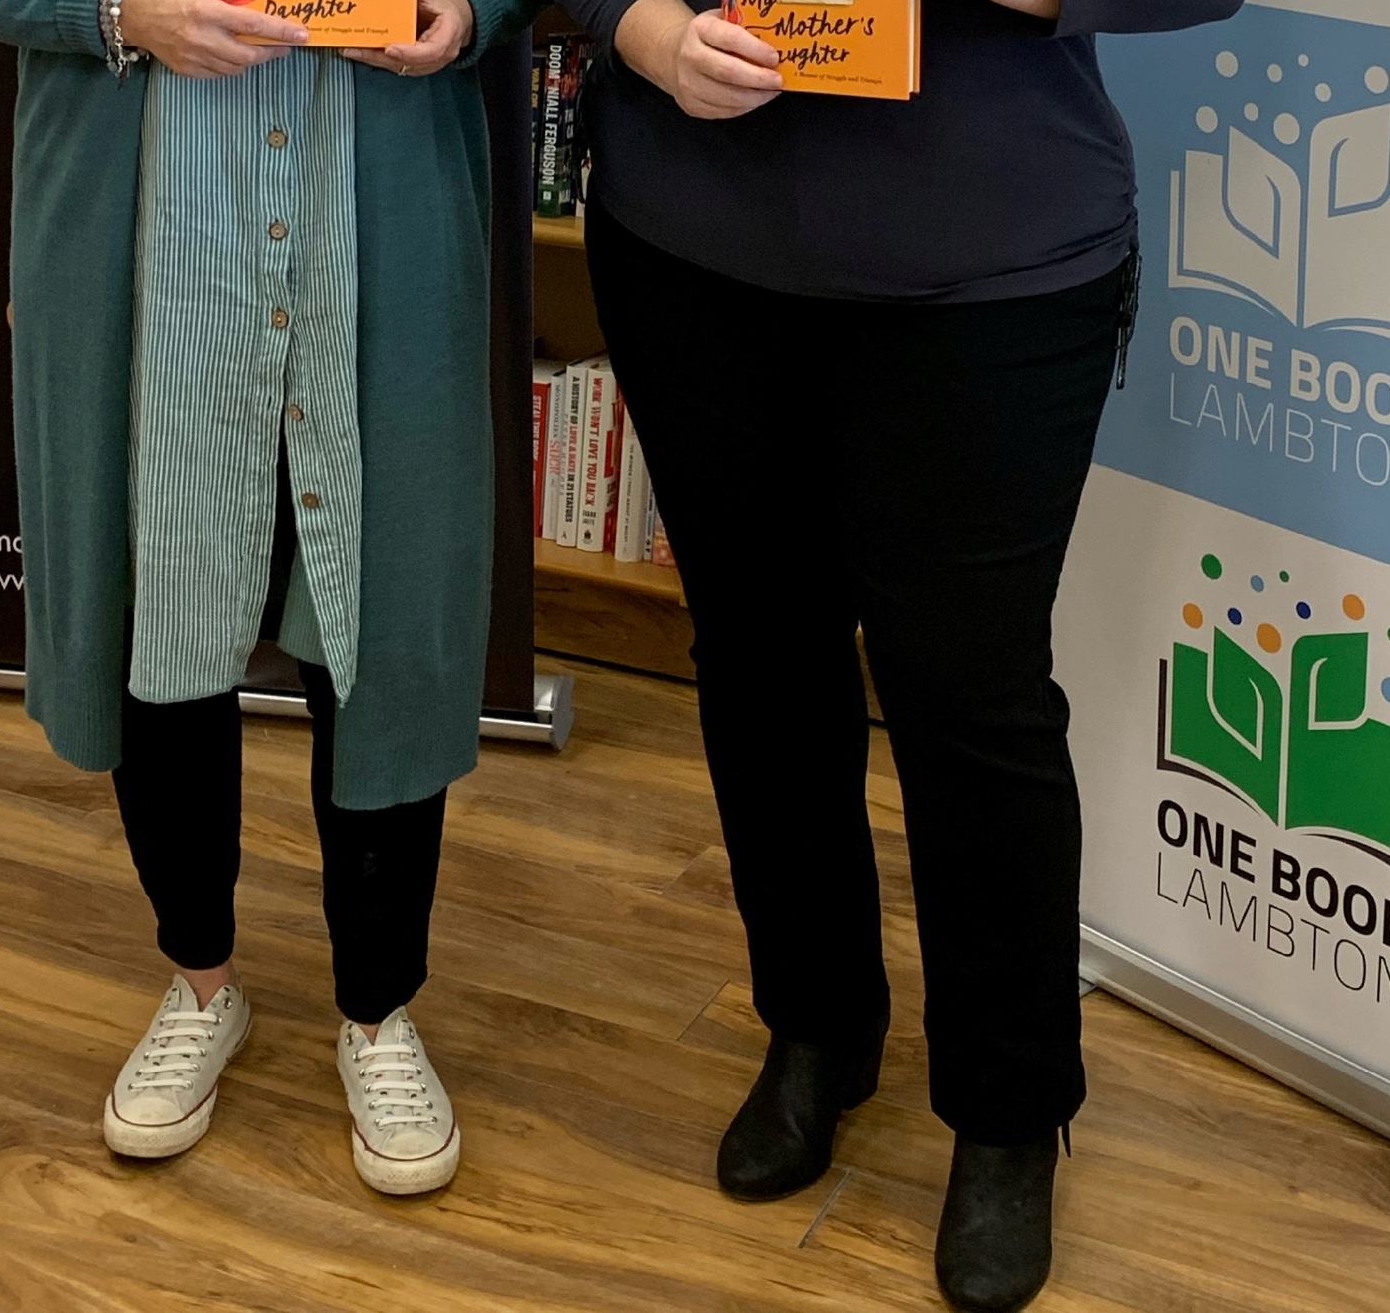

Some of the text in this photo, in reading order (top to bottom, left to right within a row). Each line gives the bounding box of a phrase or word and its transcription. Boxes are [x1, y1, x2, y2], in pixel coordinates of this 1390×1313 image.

[771, 10, 875, 40] Mother's
[548, 45, 562, 79] DOOM
[541, 87, 560, 186] NIALL FERGUSON
[1169, 316, 1273, 390] ONE
[570, 383, 580, 415] HISTORY
[592, 377, 603, 402] WORK
[549, 384, 561, 476] MONOPOLIES SUCK
[570, 415, 578, 425] OF
[589, 406, 602, 437] WON'T
[569, 426, 578, 444] LOVE
[587, 438, 599, 460] LOVE
[568, 453, 576, 473] HATE
[586, 462, 598, 481] YOU
[566, 483, 574, 491] 21
[567, 473, 575, 482] IN
[565, 492, 574, 523] STATUES
[585, 482, 597, 507] BACK
[1157, 799, 1257, 883] ONE
